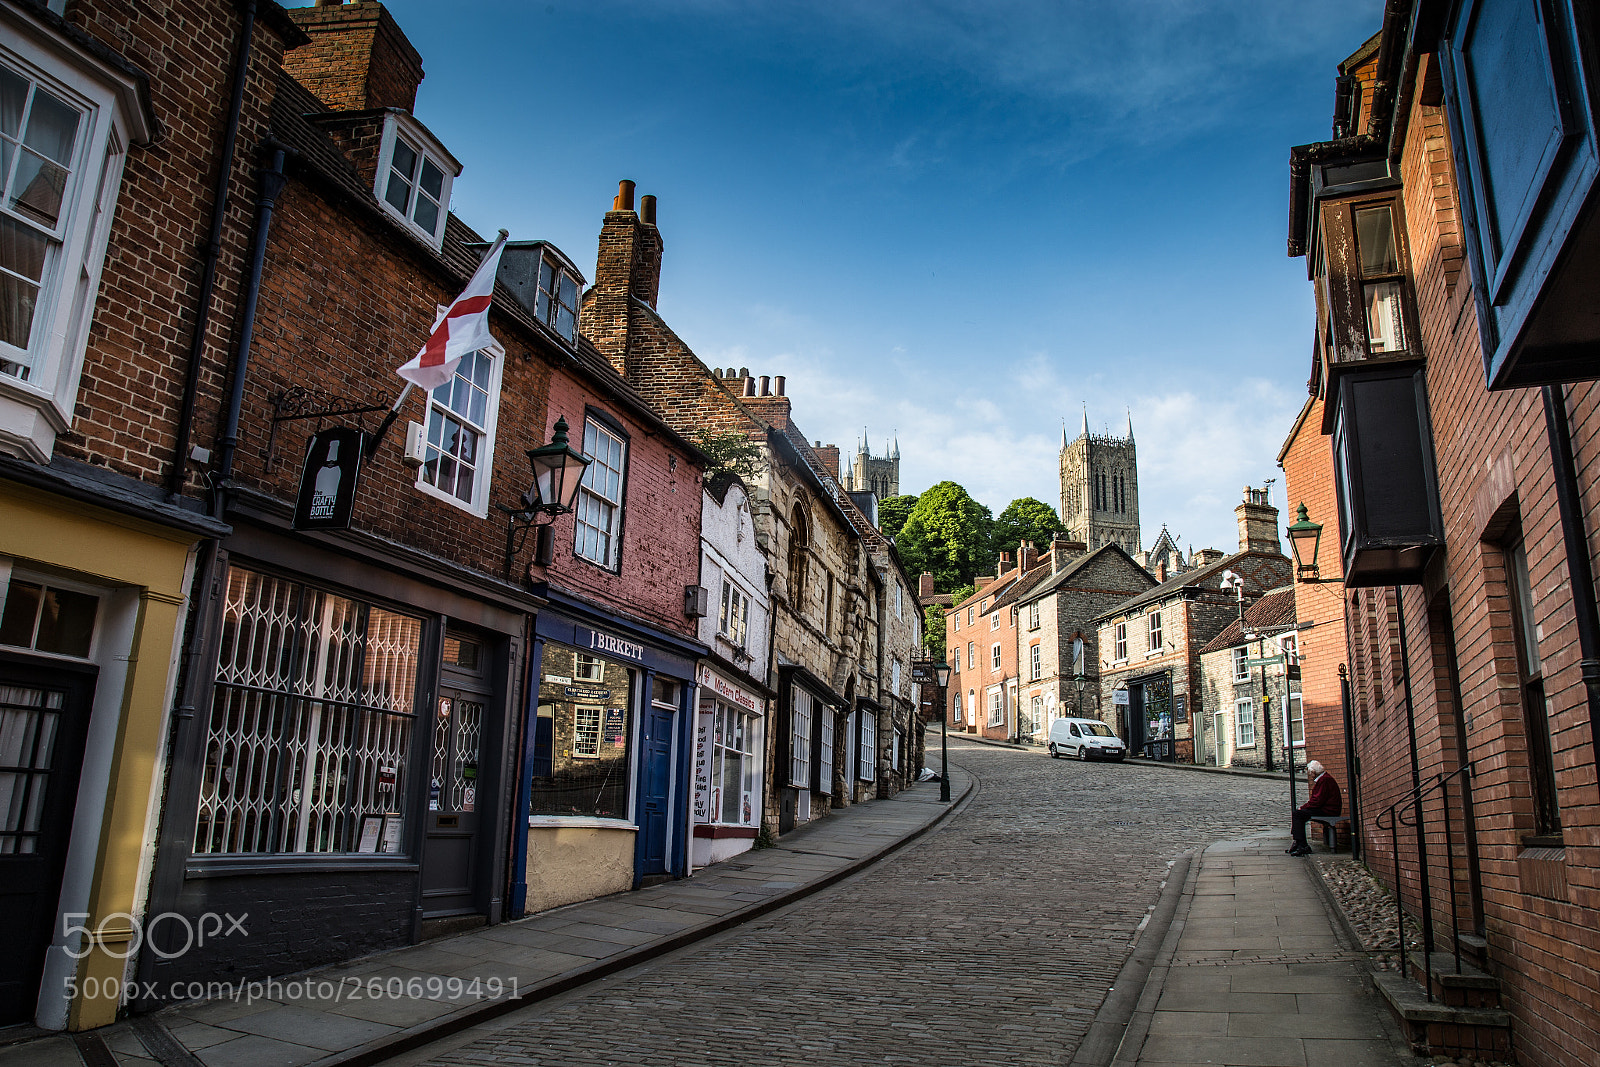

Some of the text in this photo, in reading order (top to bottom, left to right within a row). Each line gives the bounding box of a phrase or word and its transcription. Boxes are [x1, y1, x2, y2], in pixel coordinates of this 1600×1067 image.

[312, 496, 336, 505] CRAFTY
[310, 506, 334, 515] BOTTLE
[597, 632, 644, 660] BIRKETT
[714, 677, 755, 710] Modern Classics
